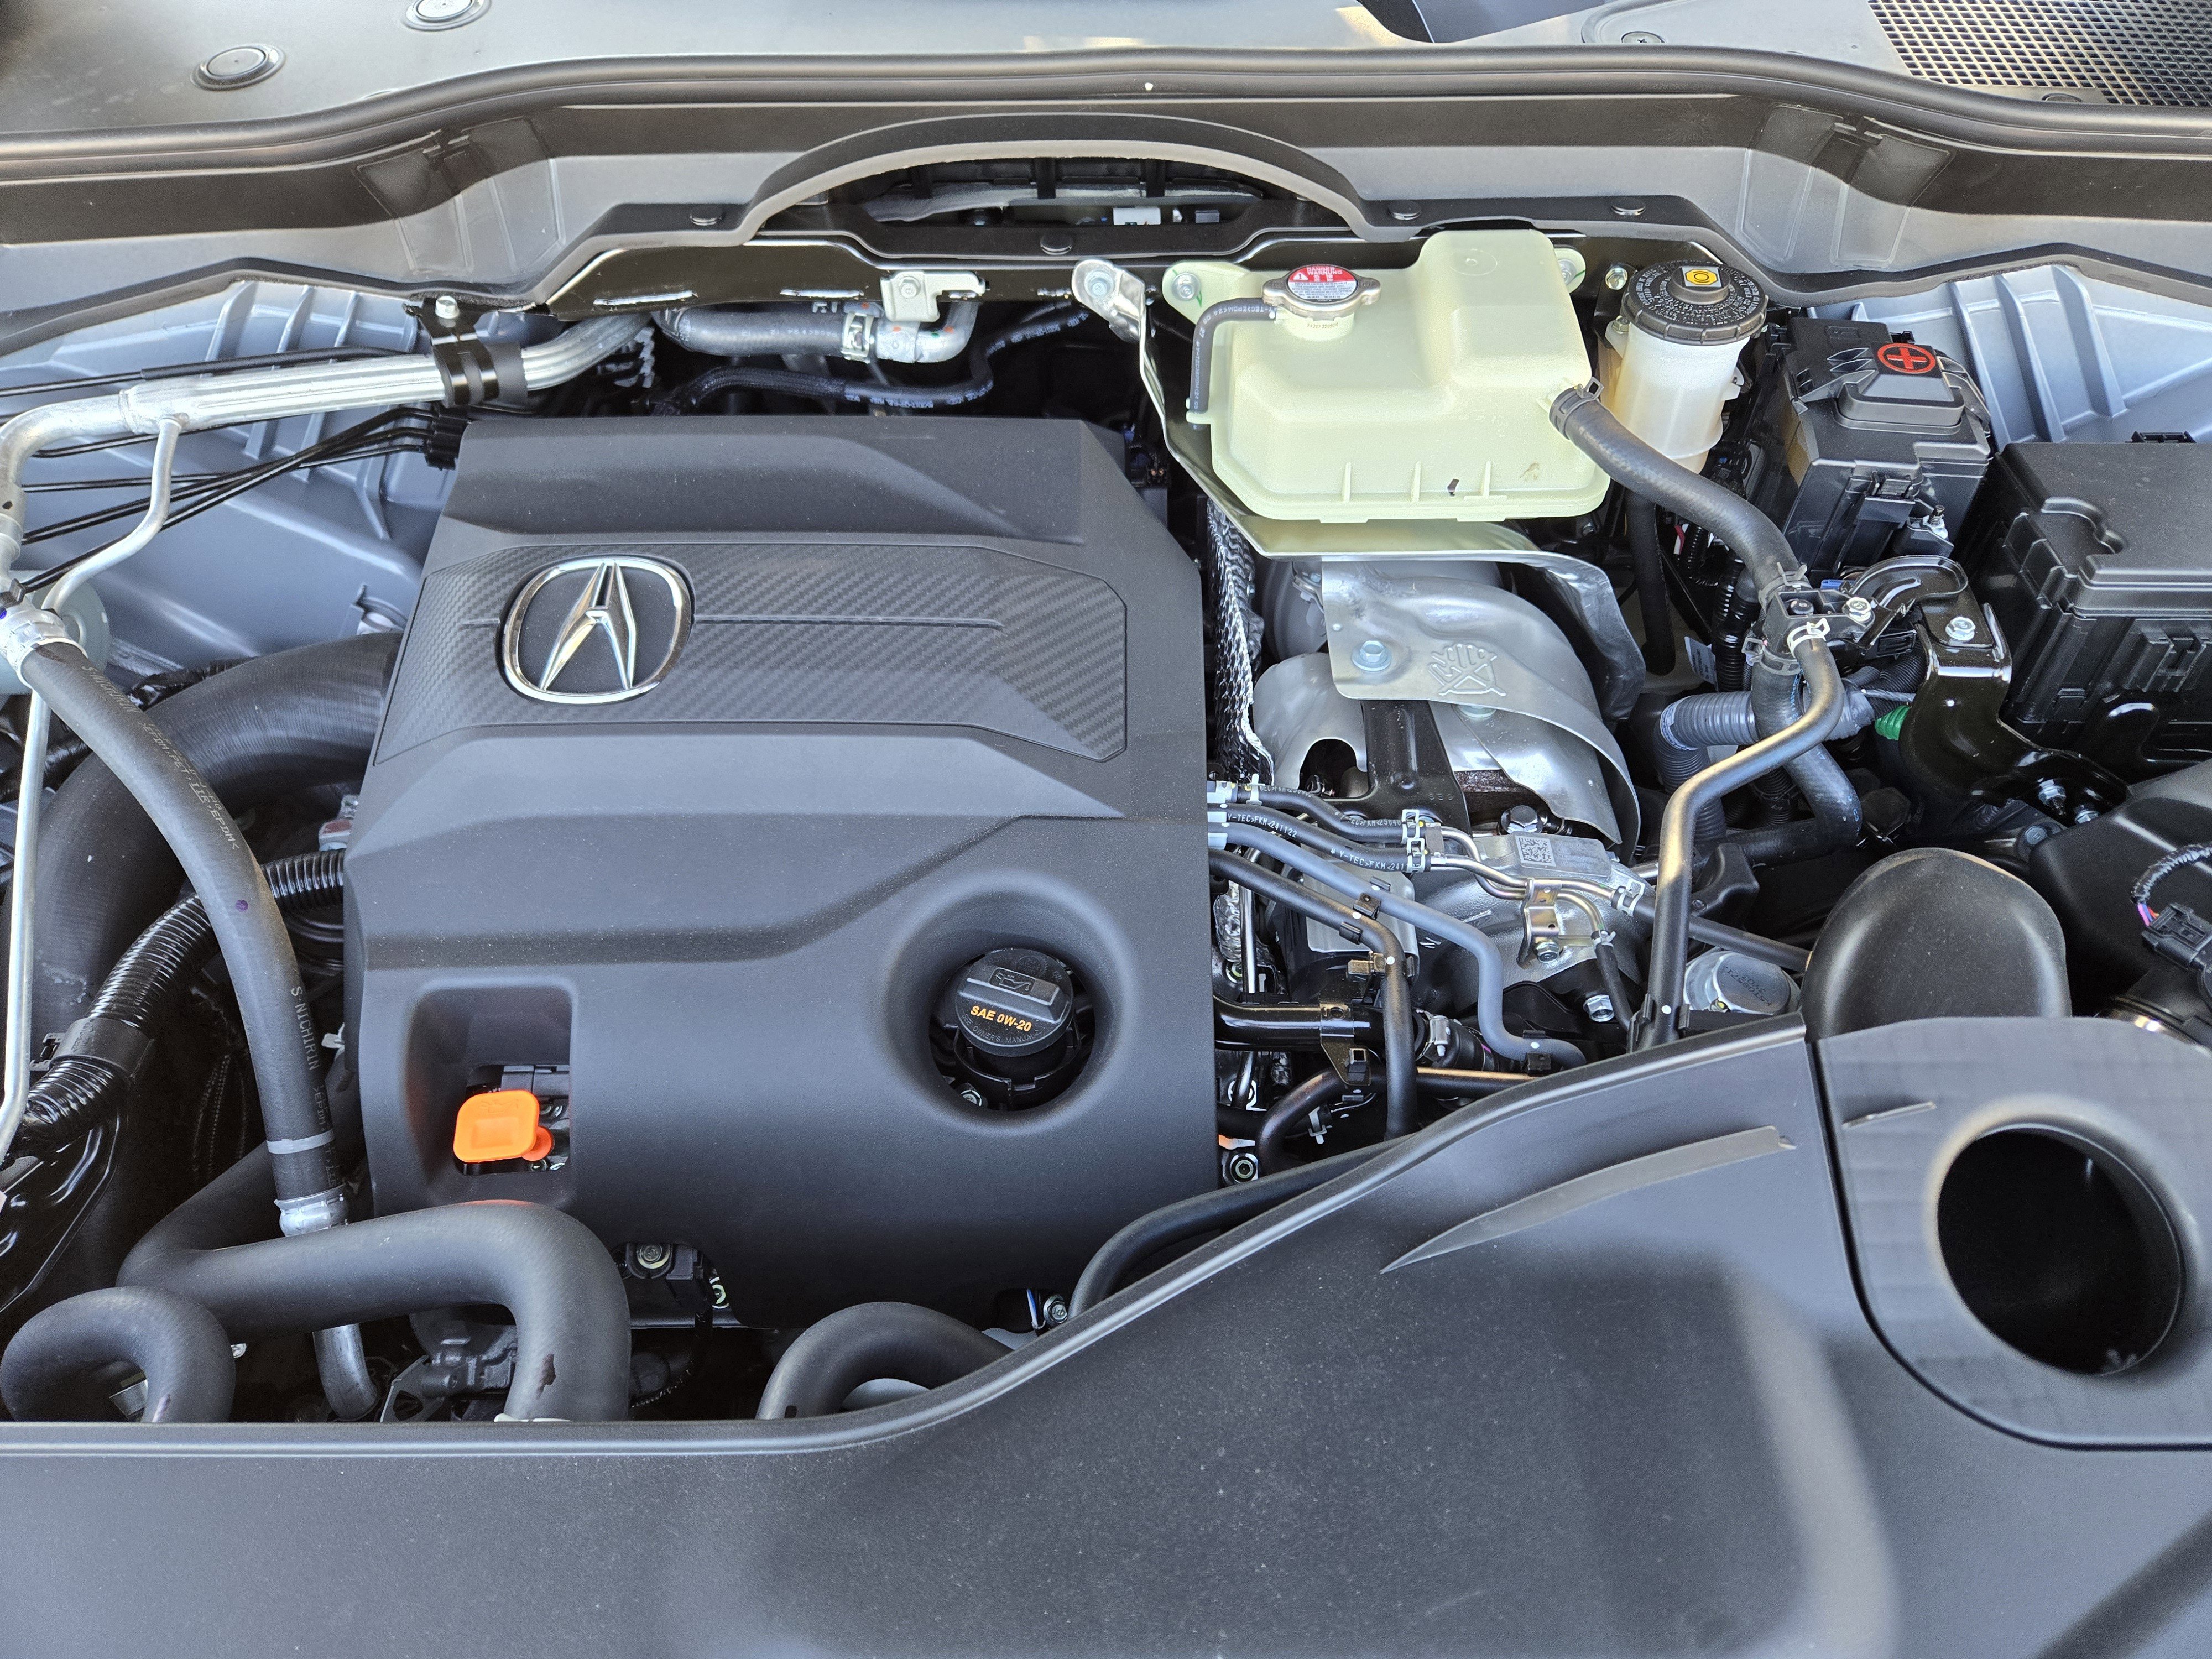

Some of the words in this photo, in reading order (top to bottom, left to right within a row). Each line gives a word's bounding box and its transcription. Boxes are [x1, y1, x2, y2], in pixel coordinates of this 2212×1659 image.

[962, 1013, 973, 1026] SEE
[972, 1025, 1001, 1042] OWNER'S
[1005, 1033, 1036, 1044] MANUAL
[970, 1005, 996, 1021] SAE
[997, 1014, 1032, 1032] 0W-20
